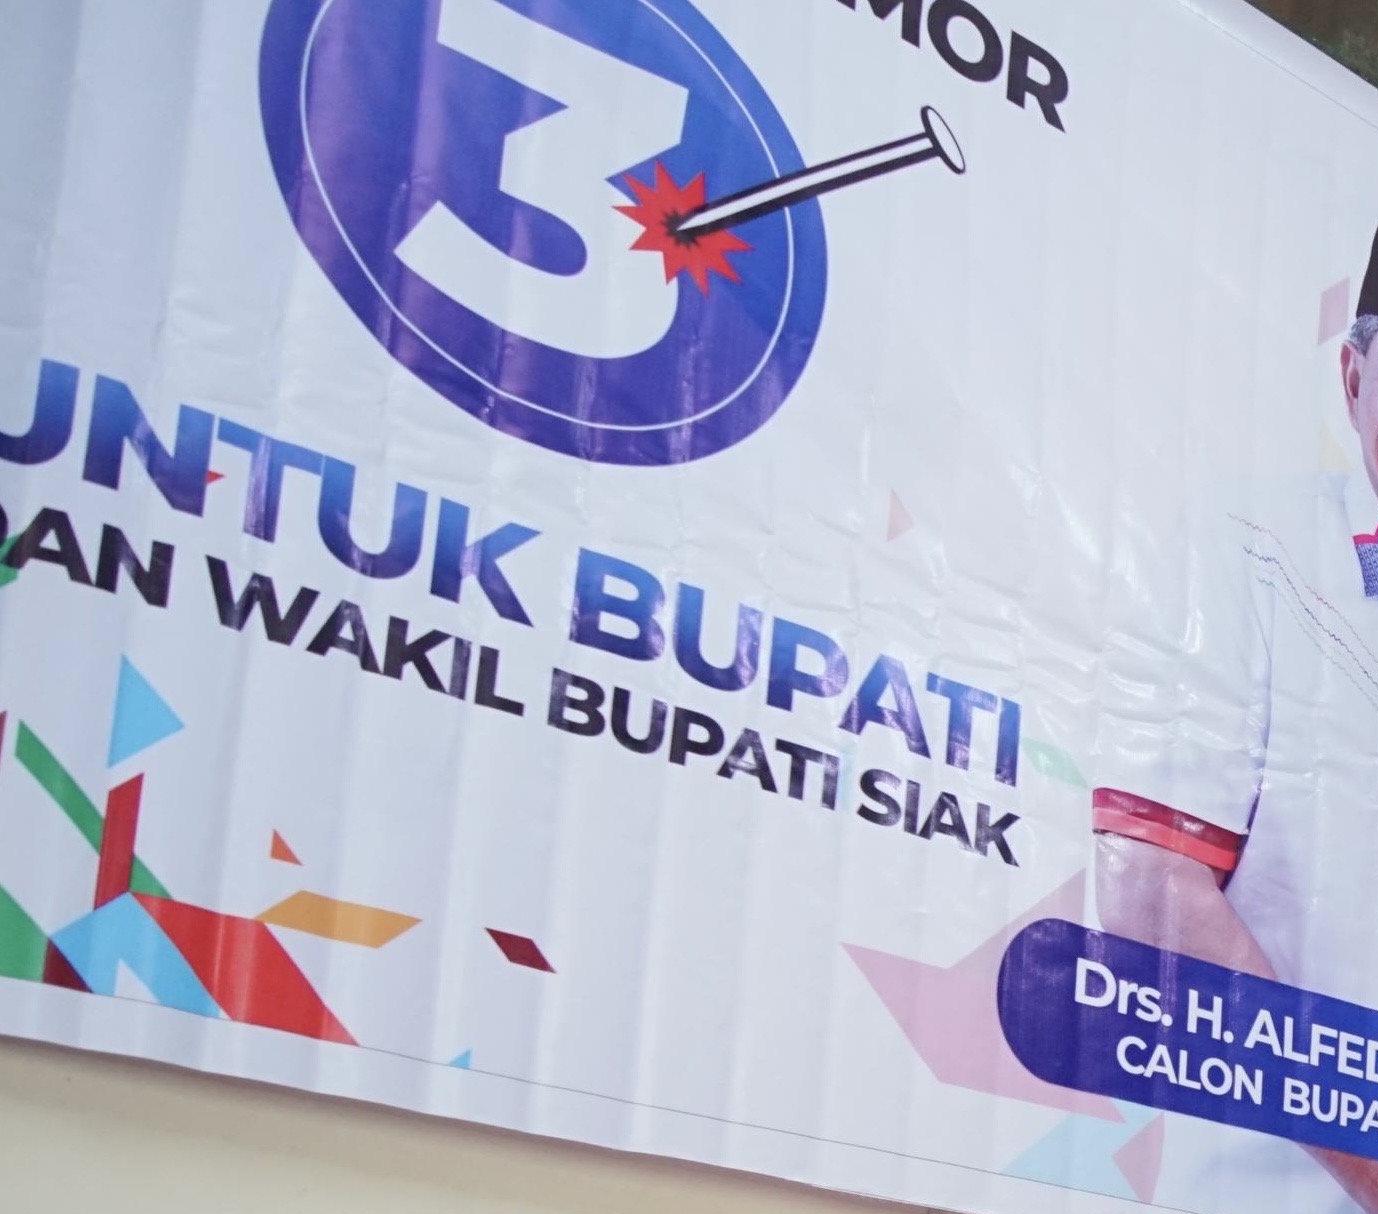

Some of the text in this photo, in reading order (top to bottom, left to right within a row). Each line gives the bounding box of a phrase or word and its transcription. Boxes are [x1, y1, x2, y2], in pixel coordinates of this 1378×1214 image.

[0, 358, 1021, 787] UNTUK BUPATI
[0, 503, 1020, 868] AN WAKIL BUPATI SIAK
[1075, 957, 1173, 1027] Drs.
[1187, 988, 1234, 1043] H.
[1116, 1036, 1263, 1105] CALON
